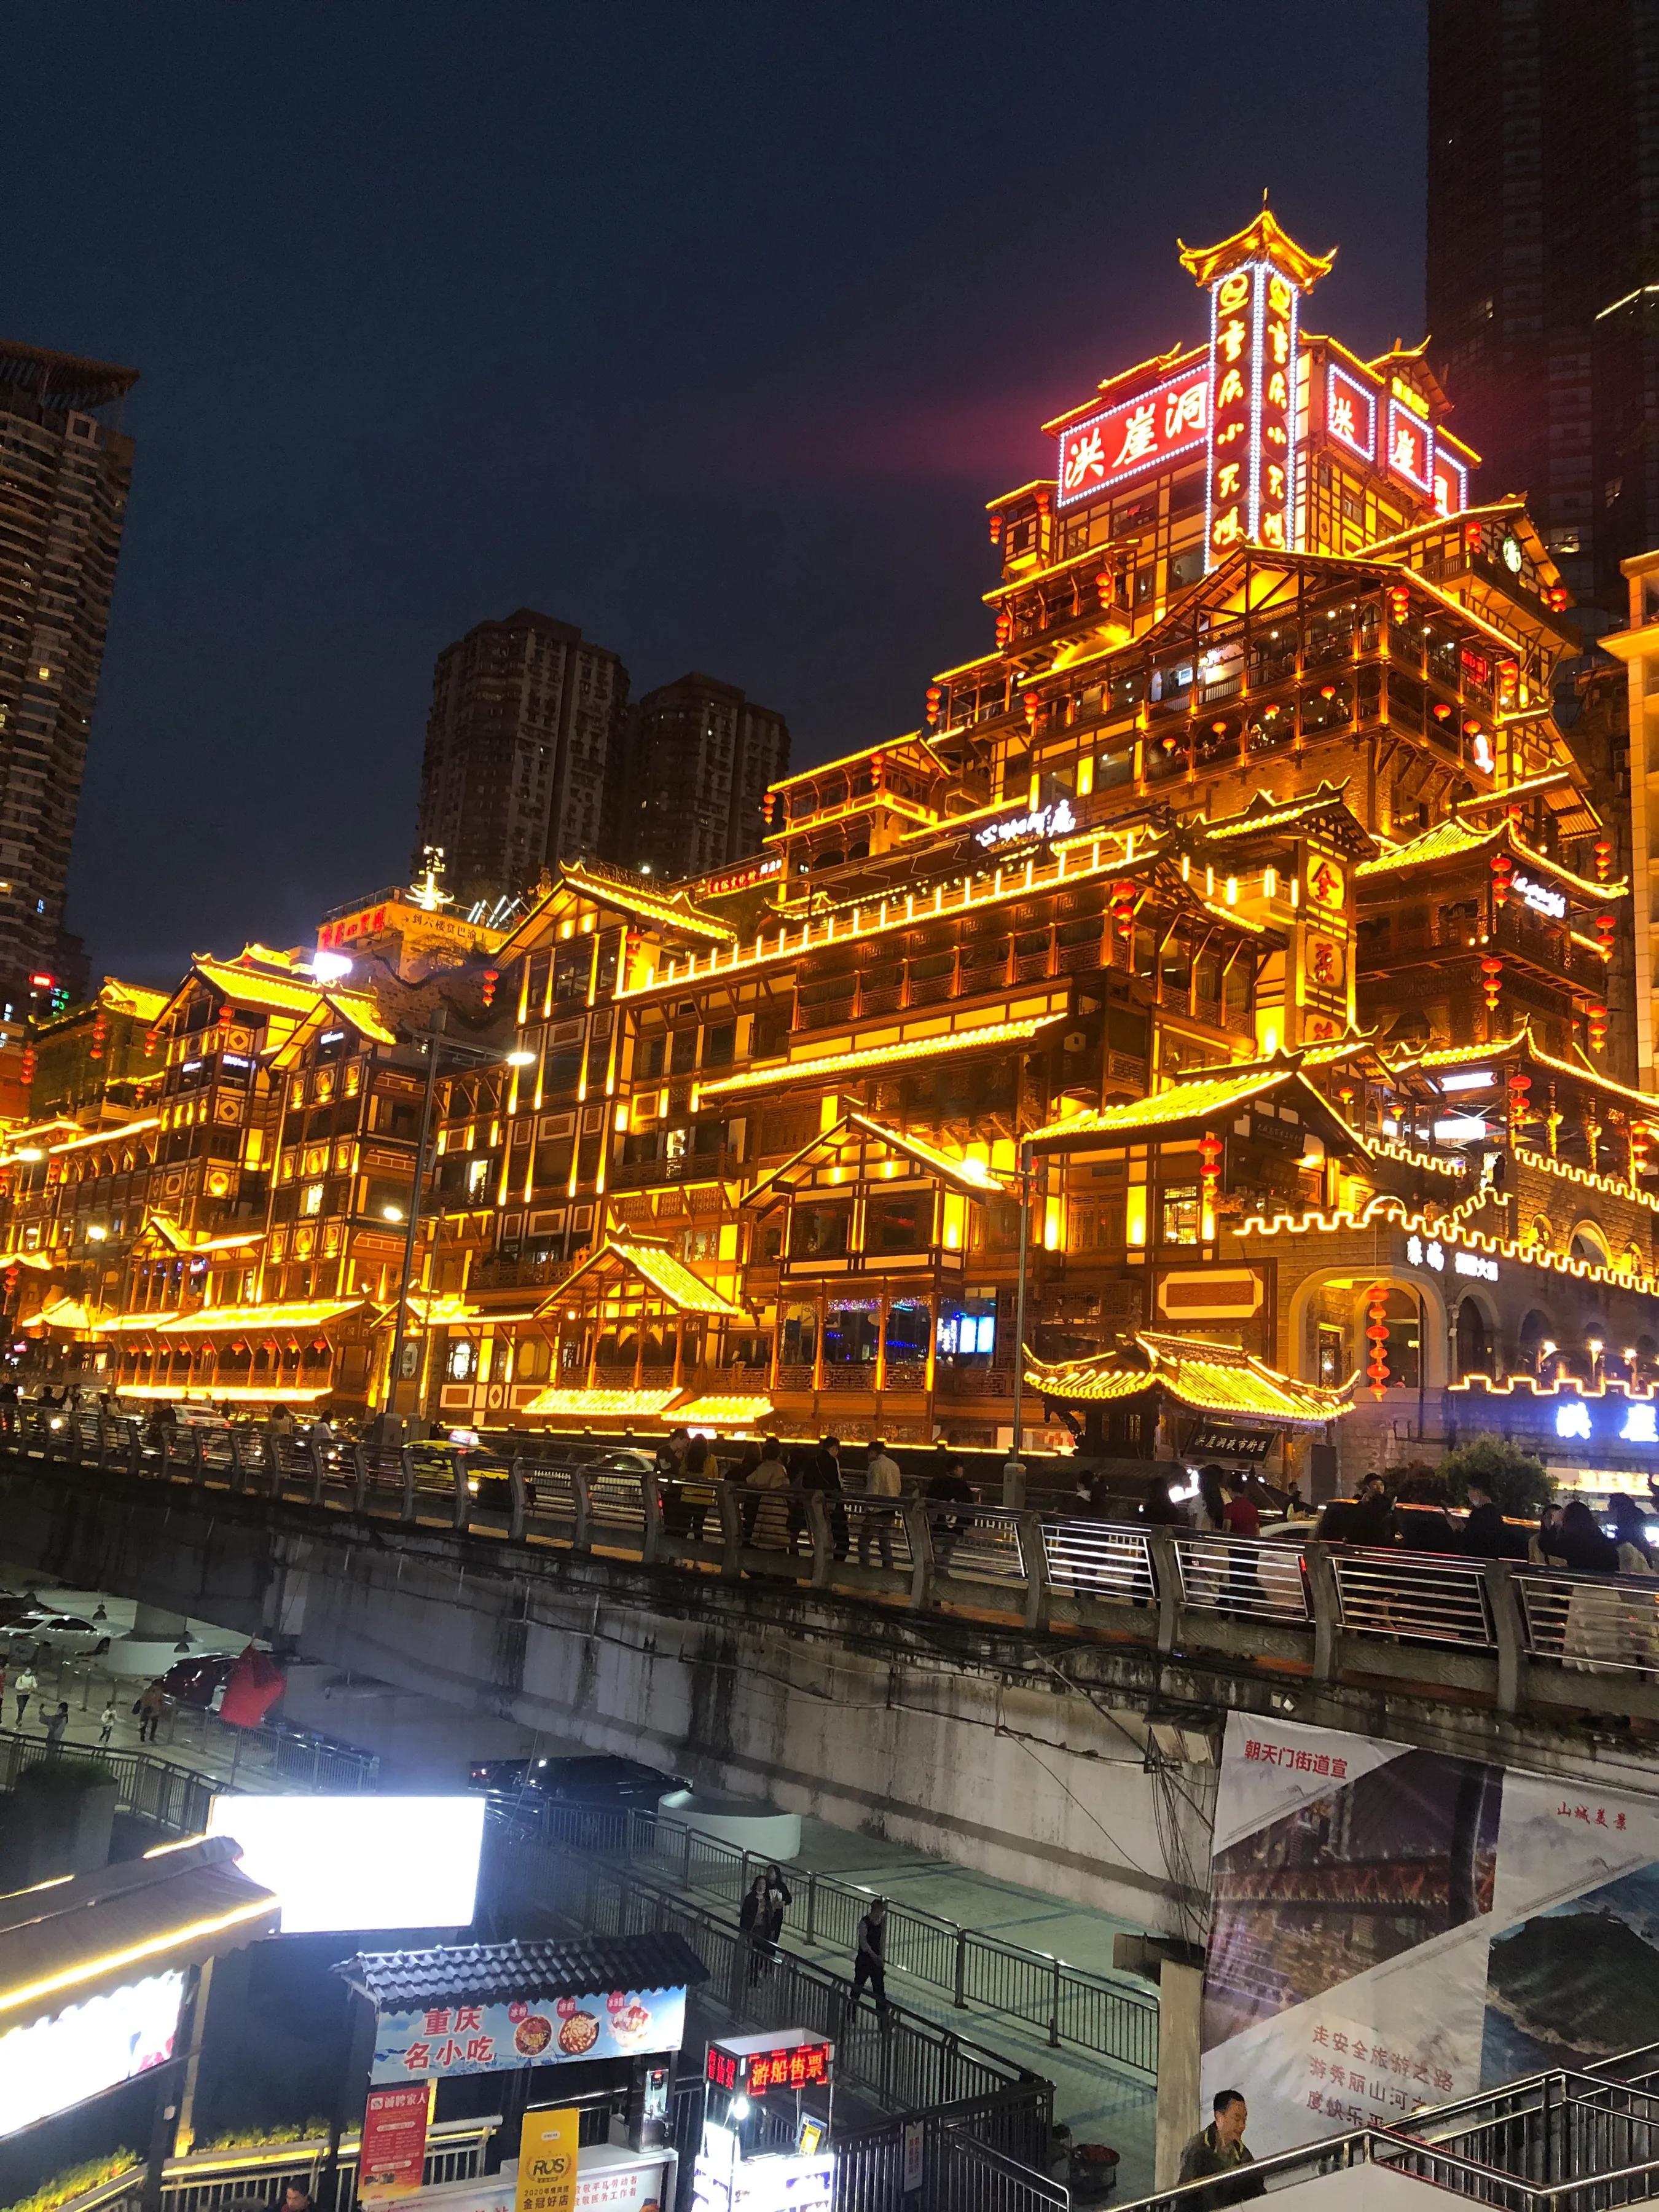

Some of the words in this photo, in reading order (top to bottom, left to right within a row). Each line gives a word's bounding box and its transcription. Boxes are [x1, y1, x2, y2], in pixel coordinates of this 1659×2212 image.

[1065, 381, 1209, 489] 洪崖洞
[1244, 1739, 1348, 1779] 朝天门街道宣
[1557, 1800, 1626, 1831] 山城美景
[423, 2007, 482, 2036] 重庆
[404, 2035, 493, 2070] 名小吃
[751, 2052, 824, 2087] 游船售票
[1312, 2025, 1454, 2093] 走安全旅游之路
[523, 2194, 569, 2210] 金冠好店
